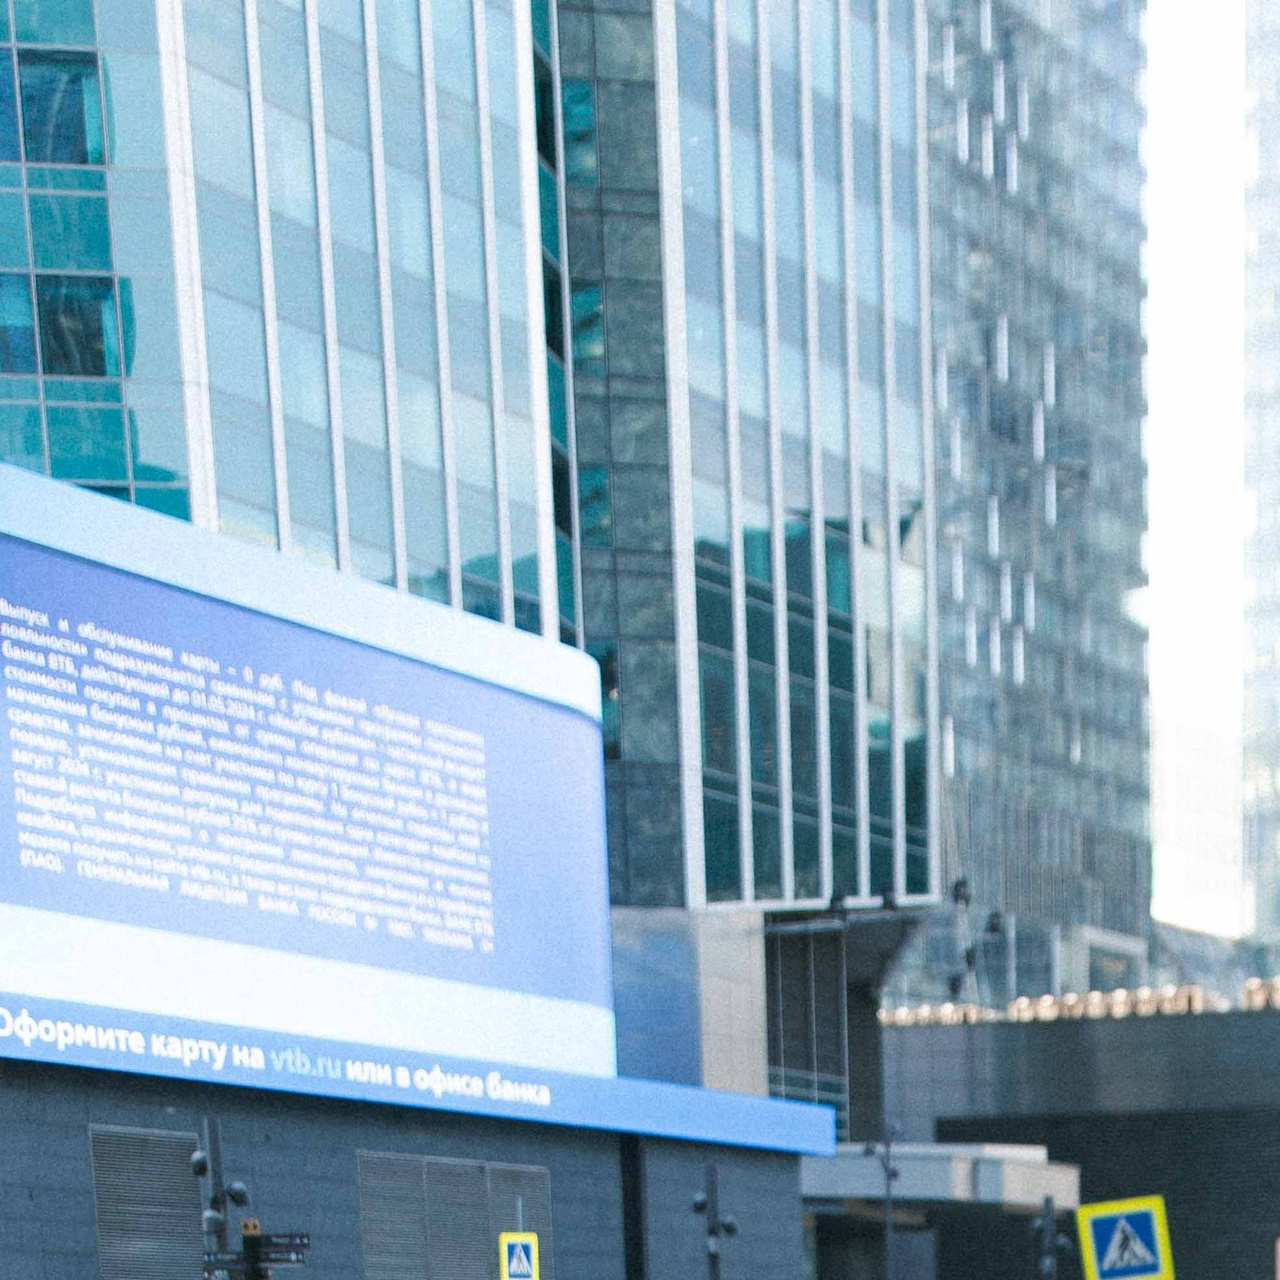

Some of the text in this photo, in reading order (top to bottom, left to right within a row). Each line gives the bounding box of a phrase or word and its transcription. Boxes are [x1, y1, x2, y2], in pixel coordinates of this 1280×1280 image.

[151, 1032, 228, 1071] карту
[232, 1043, 266, 1070] на
[270, 1046, 343, 1079] vtb.ru
[345, 1059, 393, 1086] или
[395, 1065, 411, 1089] в
[412, 1063, 484, 1099] офисе
[485, 1070, 551, 1106] банка
